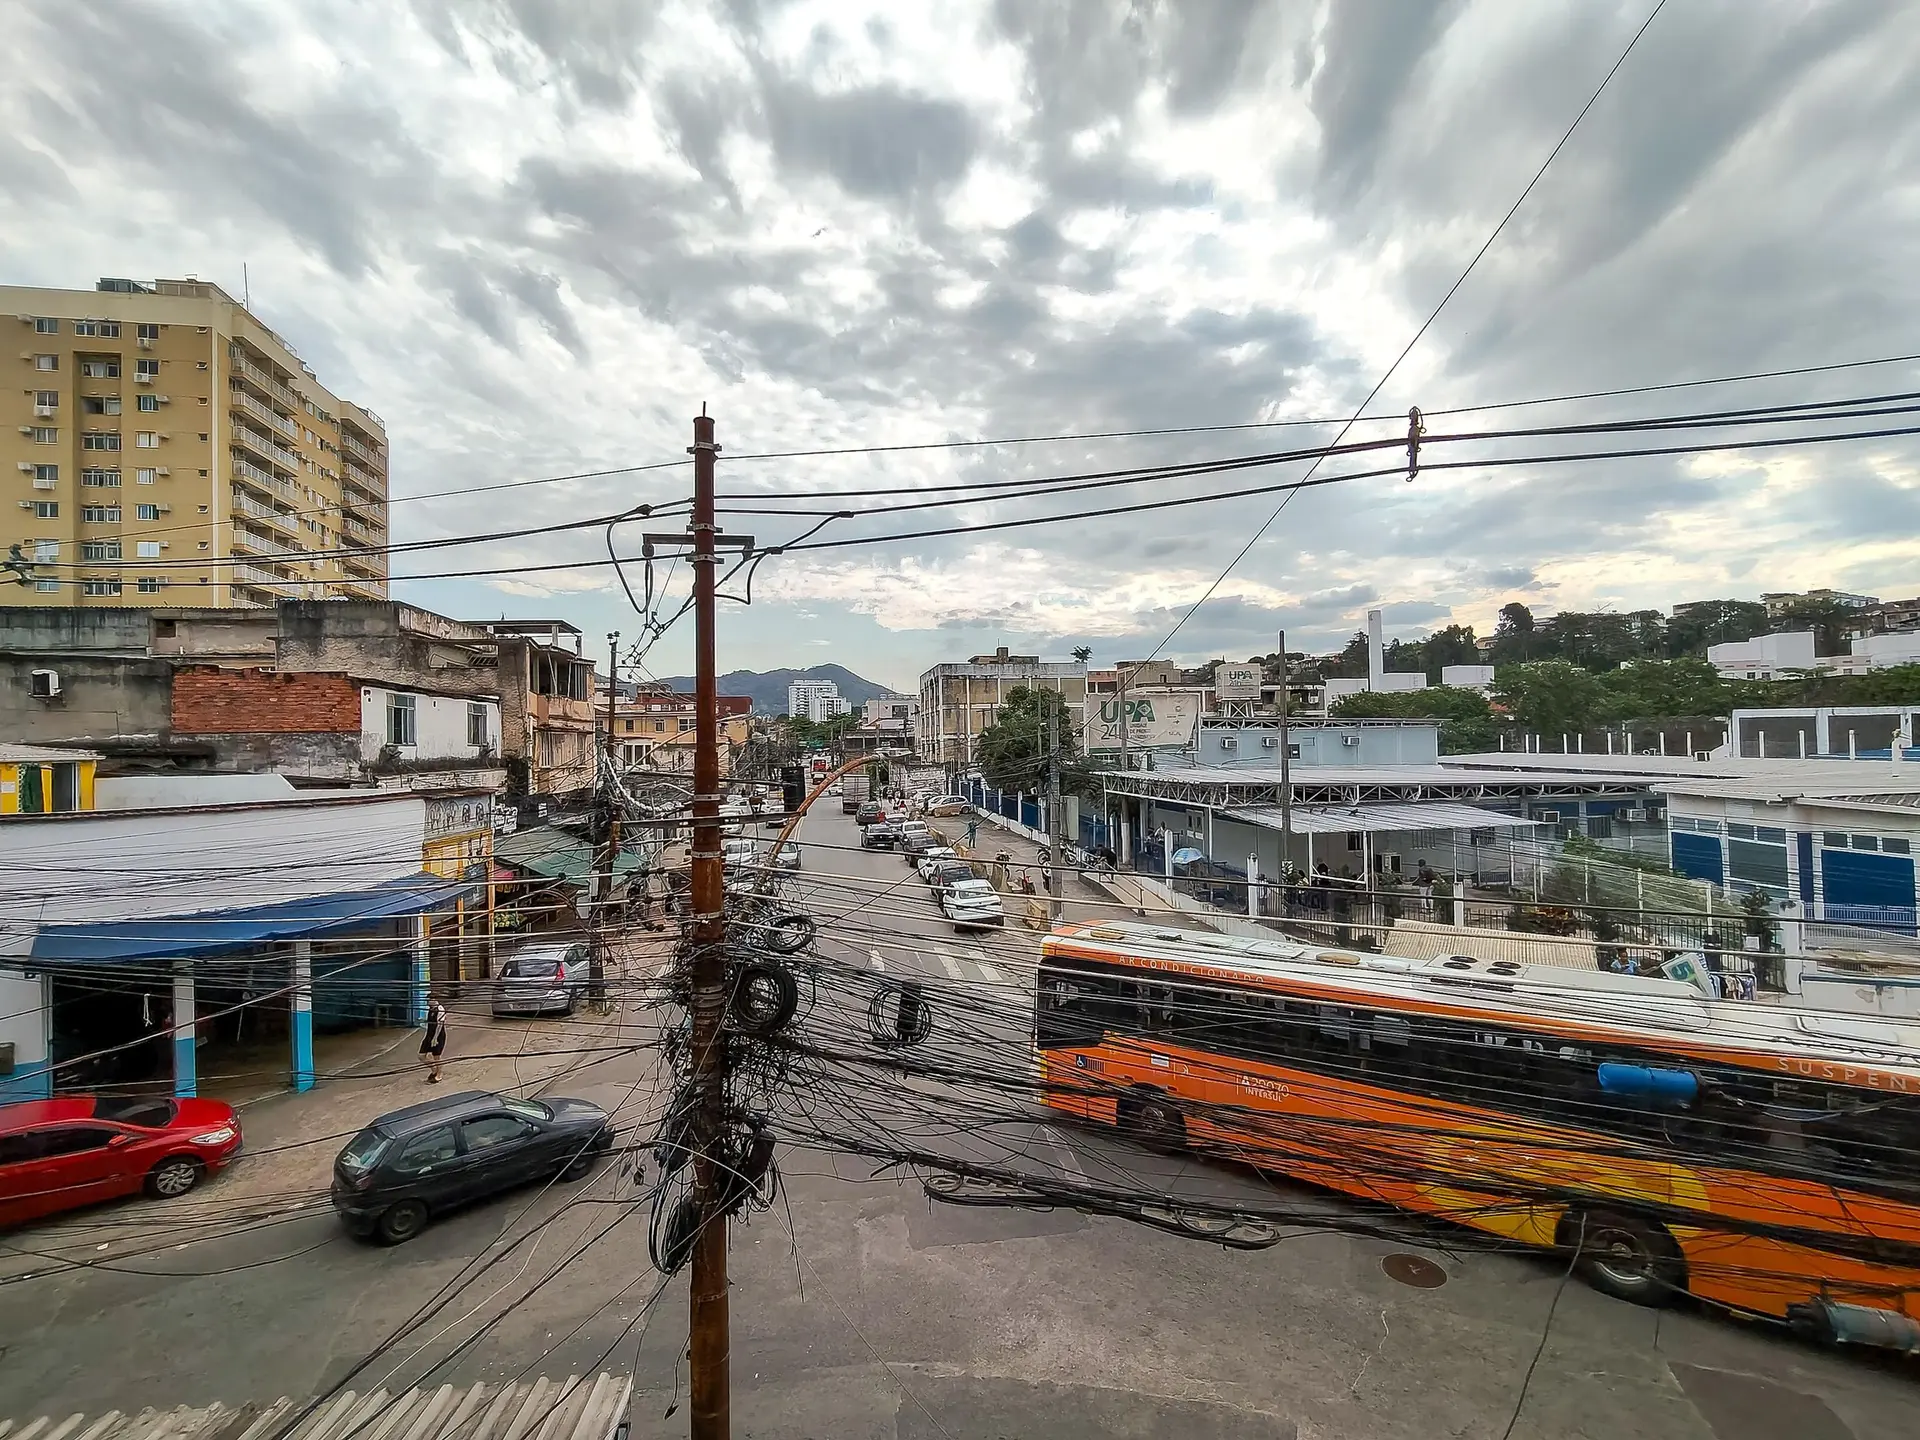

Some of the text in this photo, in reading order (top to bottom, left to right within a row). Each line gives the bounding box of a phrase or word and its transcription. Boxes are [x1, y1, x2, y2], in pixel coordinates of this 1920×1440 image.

[1229, 671, 1253, 680] UPA
[1100, 699, 1156, 723] UPA
[1776, 1057, 1920, 1093] SUSPEN
[1245, 1086, 1283, 1103] INTERSUL
